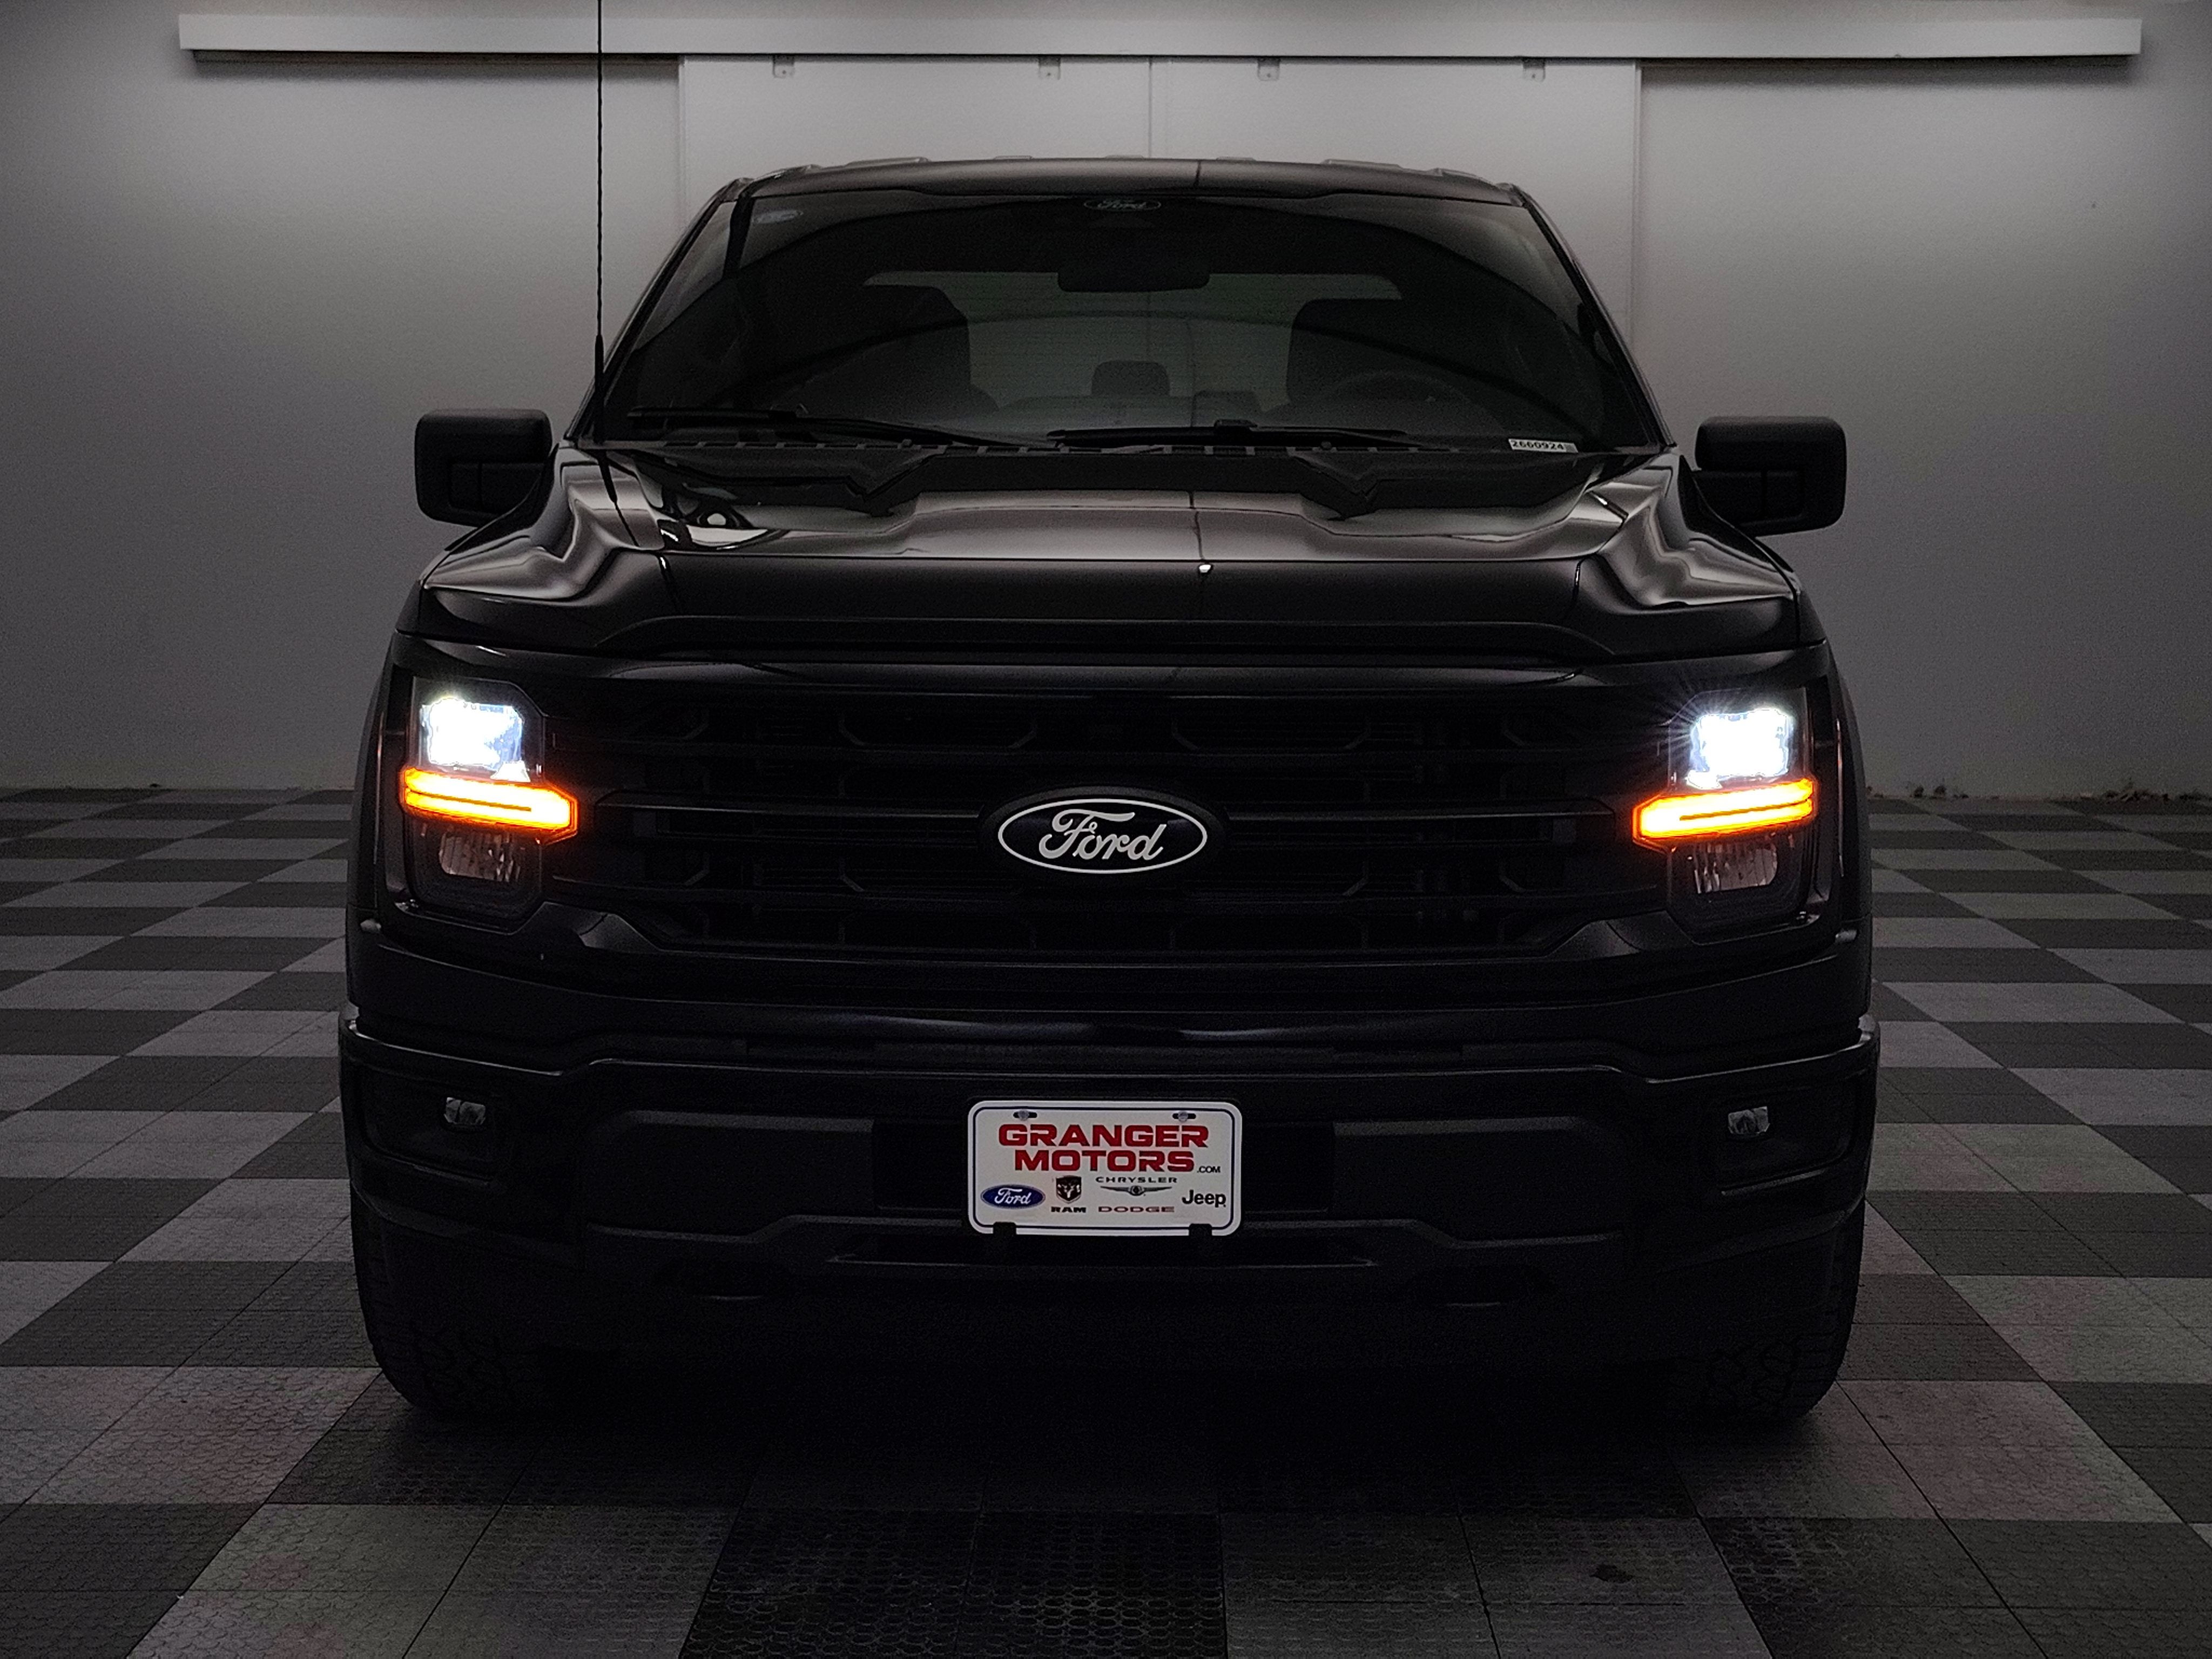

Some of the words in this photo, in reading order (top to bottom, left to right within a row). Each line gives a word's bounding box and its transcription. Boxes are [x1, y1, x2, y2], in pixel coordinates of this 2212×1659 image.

[1038, 808, 1167, 860] Ford
[999, 1123, 1210, 1148] GRANGER
[1014, 1149, 1195, 1172] MOTORS
[994, 1188, 1031, 1205] Ford
[1181, 1189, 1226, 1208] Jeep
